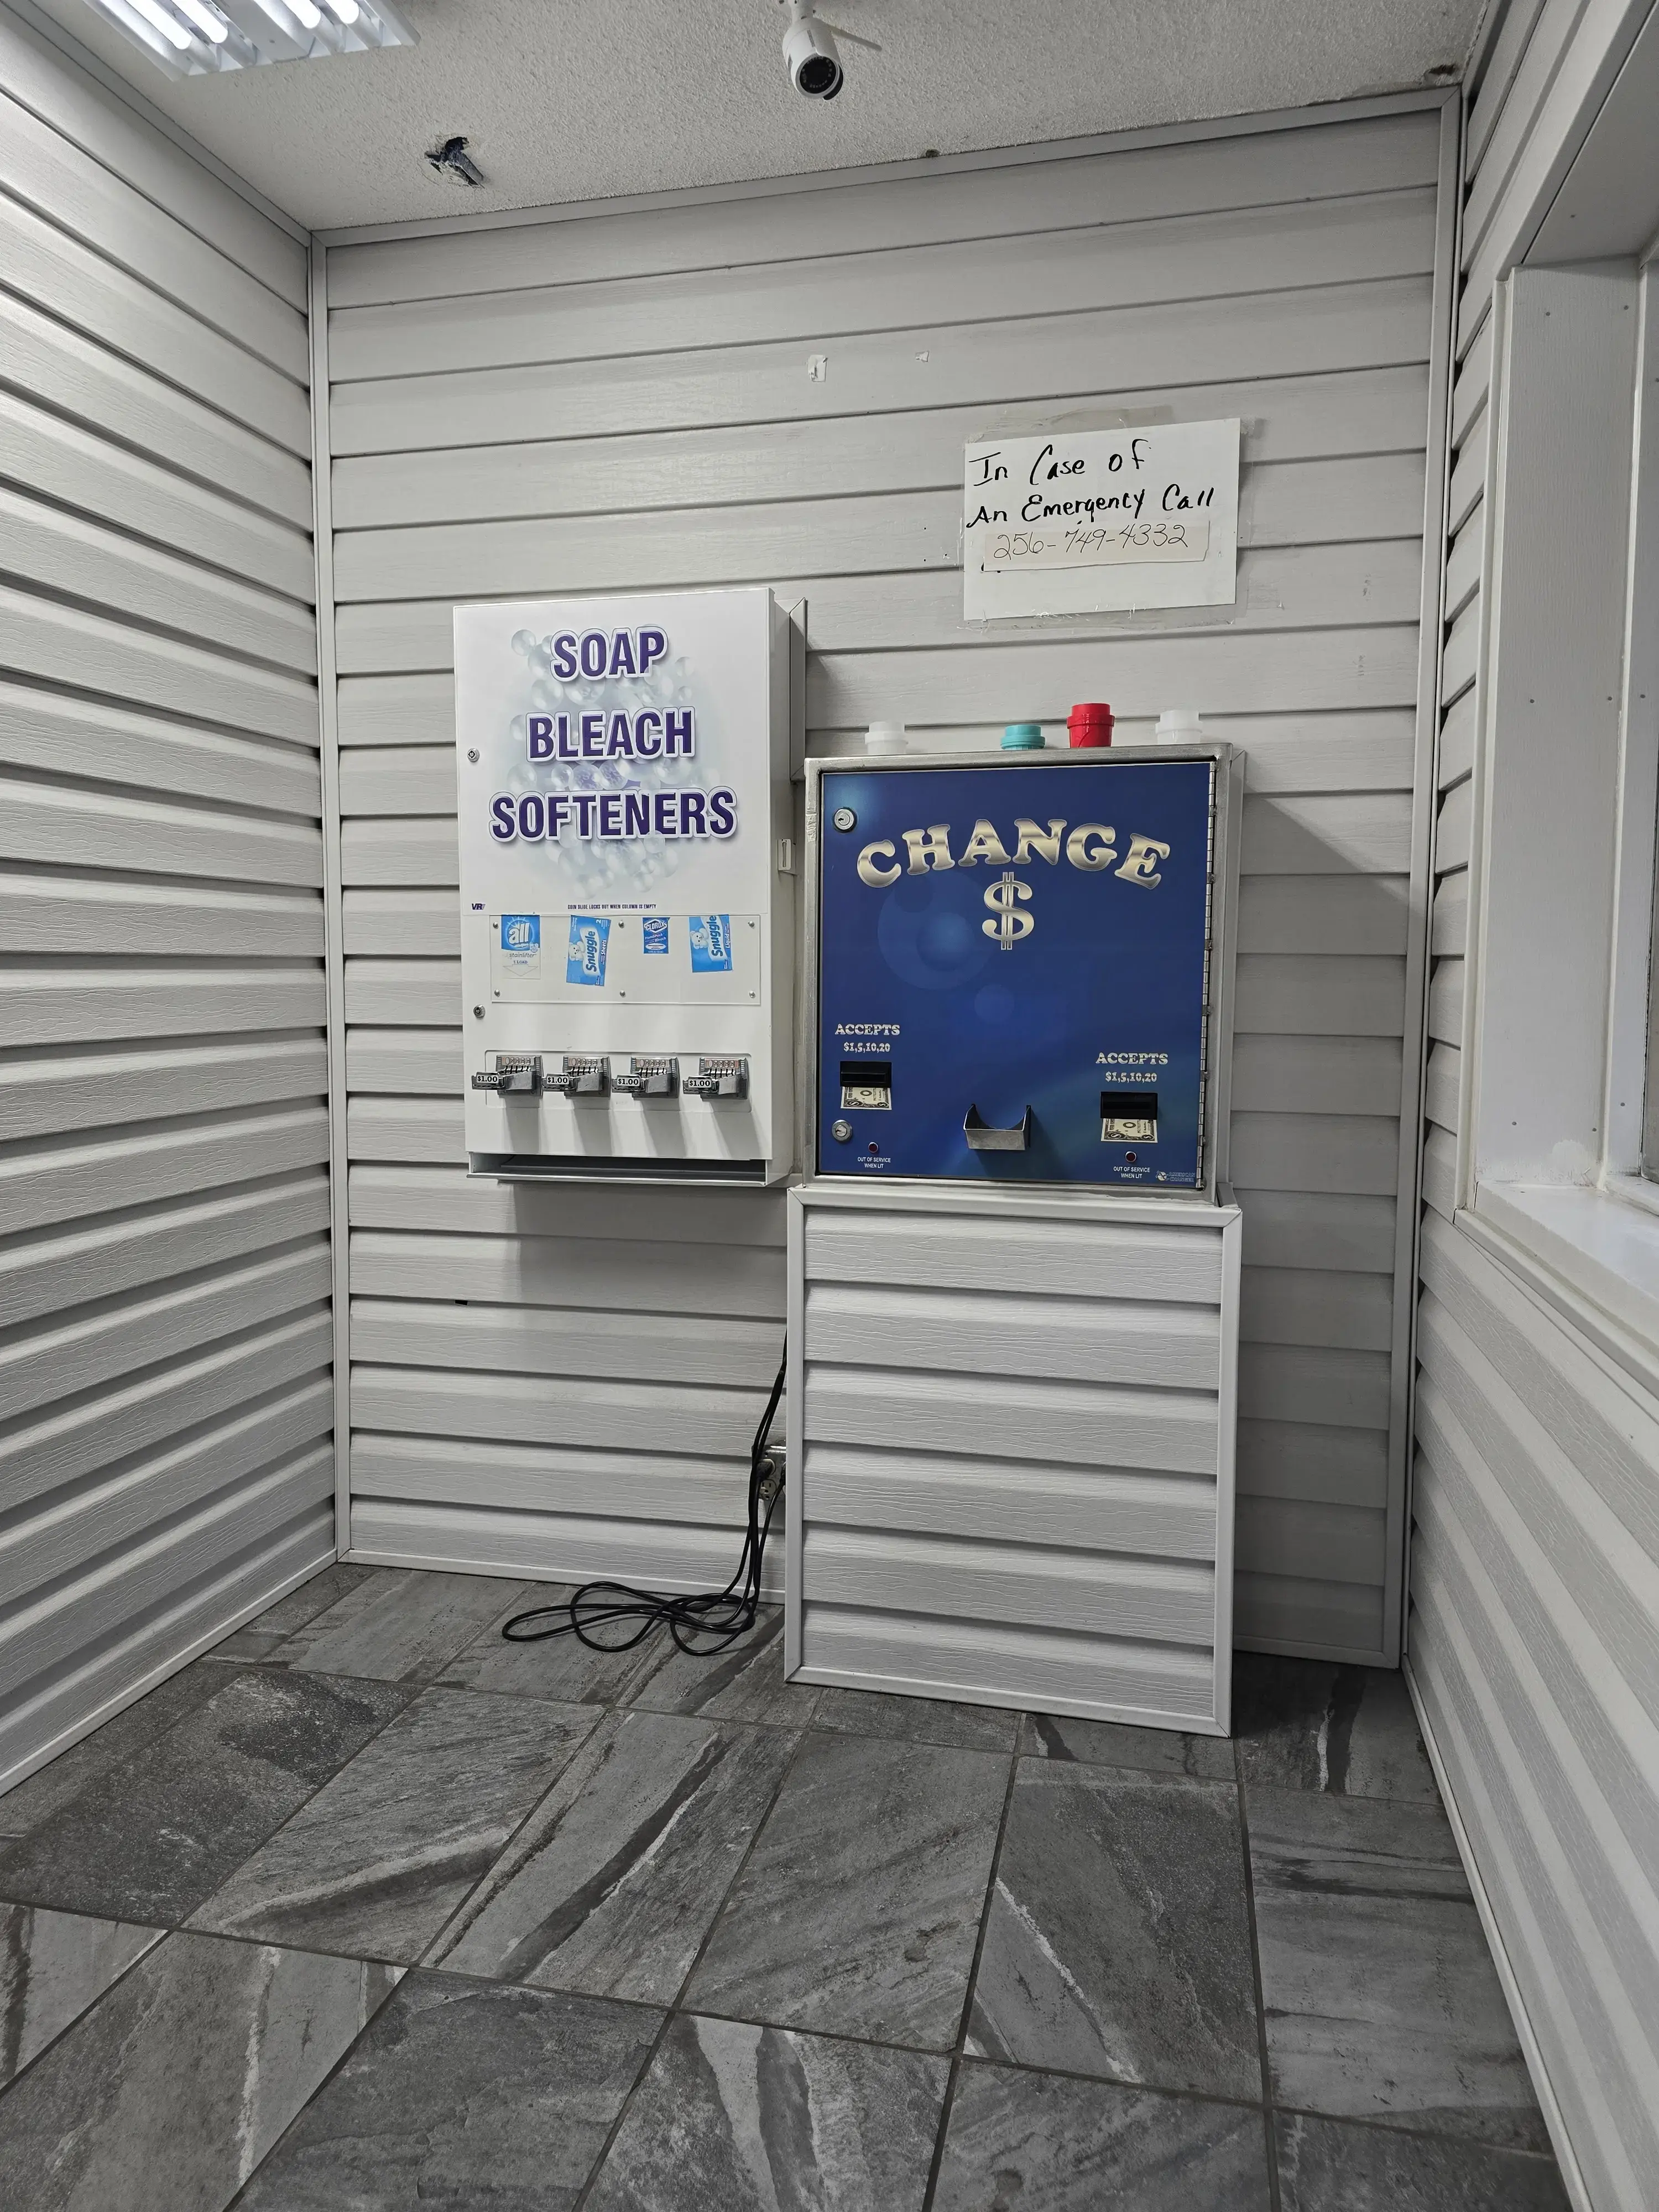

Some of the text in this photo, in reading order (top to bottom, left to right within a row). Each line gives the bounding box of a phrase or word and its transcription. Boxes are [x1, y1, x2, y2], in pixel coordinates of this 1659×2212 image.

[968, 439, 1149, 487] In Case of
[966, 483, 1214, 528] An Emergency Call
[993, 523, 1188, 560] 256-749-4332
[552, 628, 666, 680] SOAP
[528, 708, 693, 760] BLEACH
[491, 789, 735, 841] SOFTENERS
[857, 818, 1171, 890] CHANGE
[508, 922, 530, 945] all
[646, 920, 665, 931] CLOROX
[706, 915, 723, 957] Snuggle
[585, 930, 598, 972] Snuggle
[834, 1023, 900, 1036] ACCEPTS
[843, 1041, 891, 1053] $1,5,10,20
[1095, 1052, 1168, 1065] ACCEPTS
[1105, 1071, 1157, 1084] $1,5,10,20
